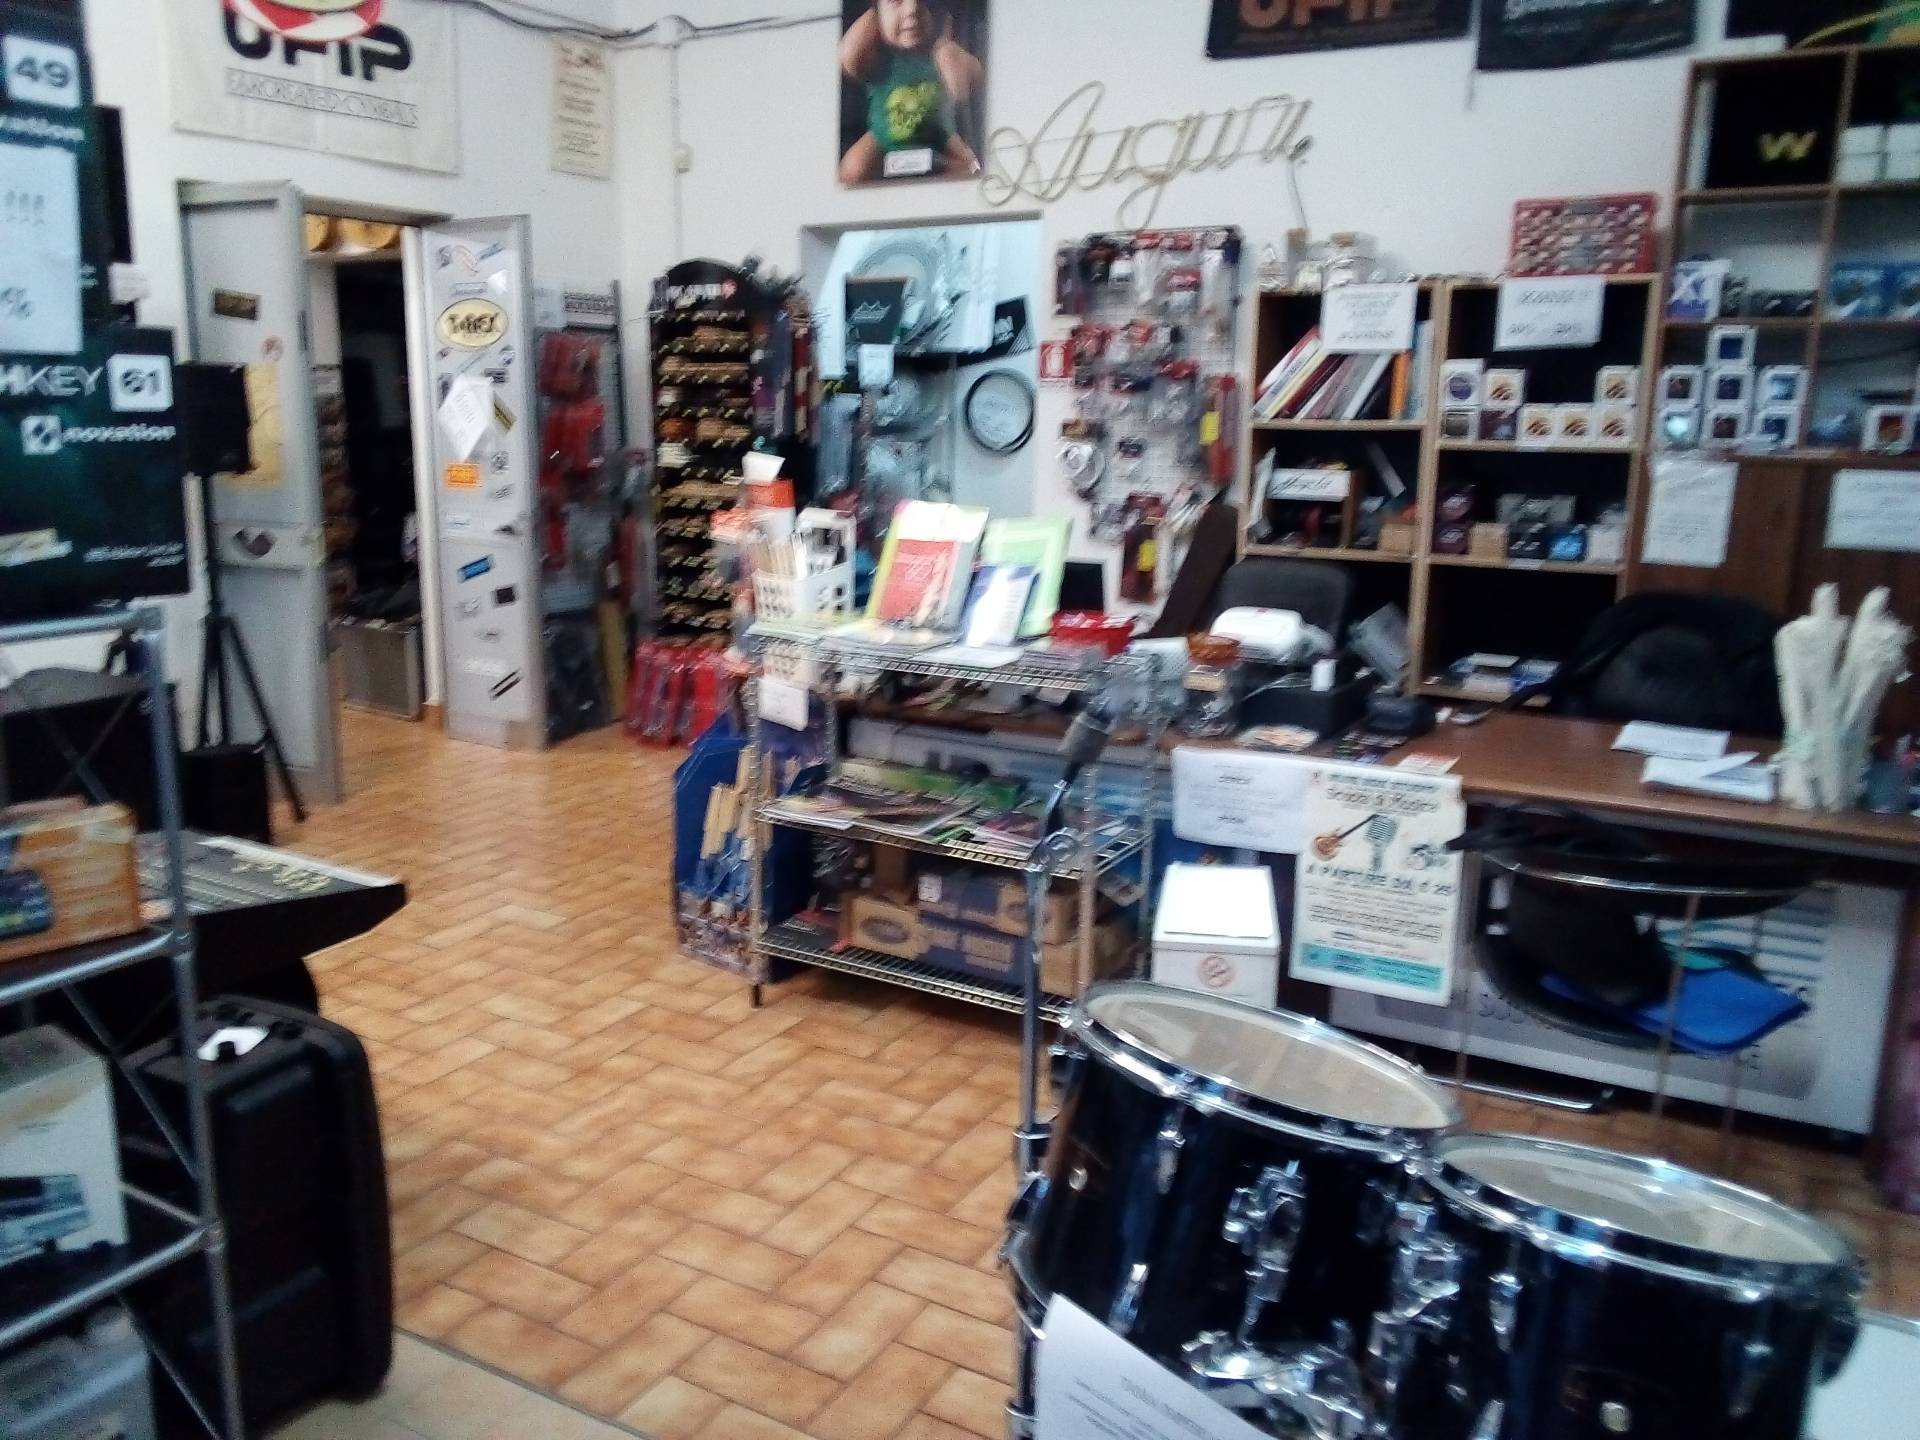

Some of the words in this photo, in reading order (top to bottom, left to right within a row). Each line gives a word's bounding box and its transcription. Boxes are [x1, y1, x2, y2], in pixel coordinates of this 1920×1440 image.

[15, 56, 73, 88] 49
[120, 367, 162, 396] 61
[62, 423, 177, 444] novation
